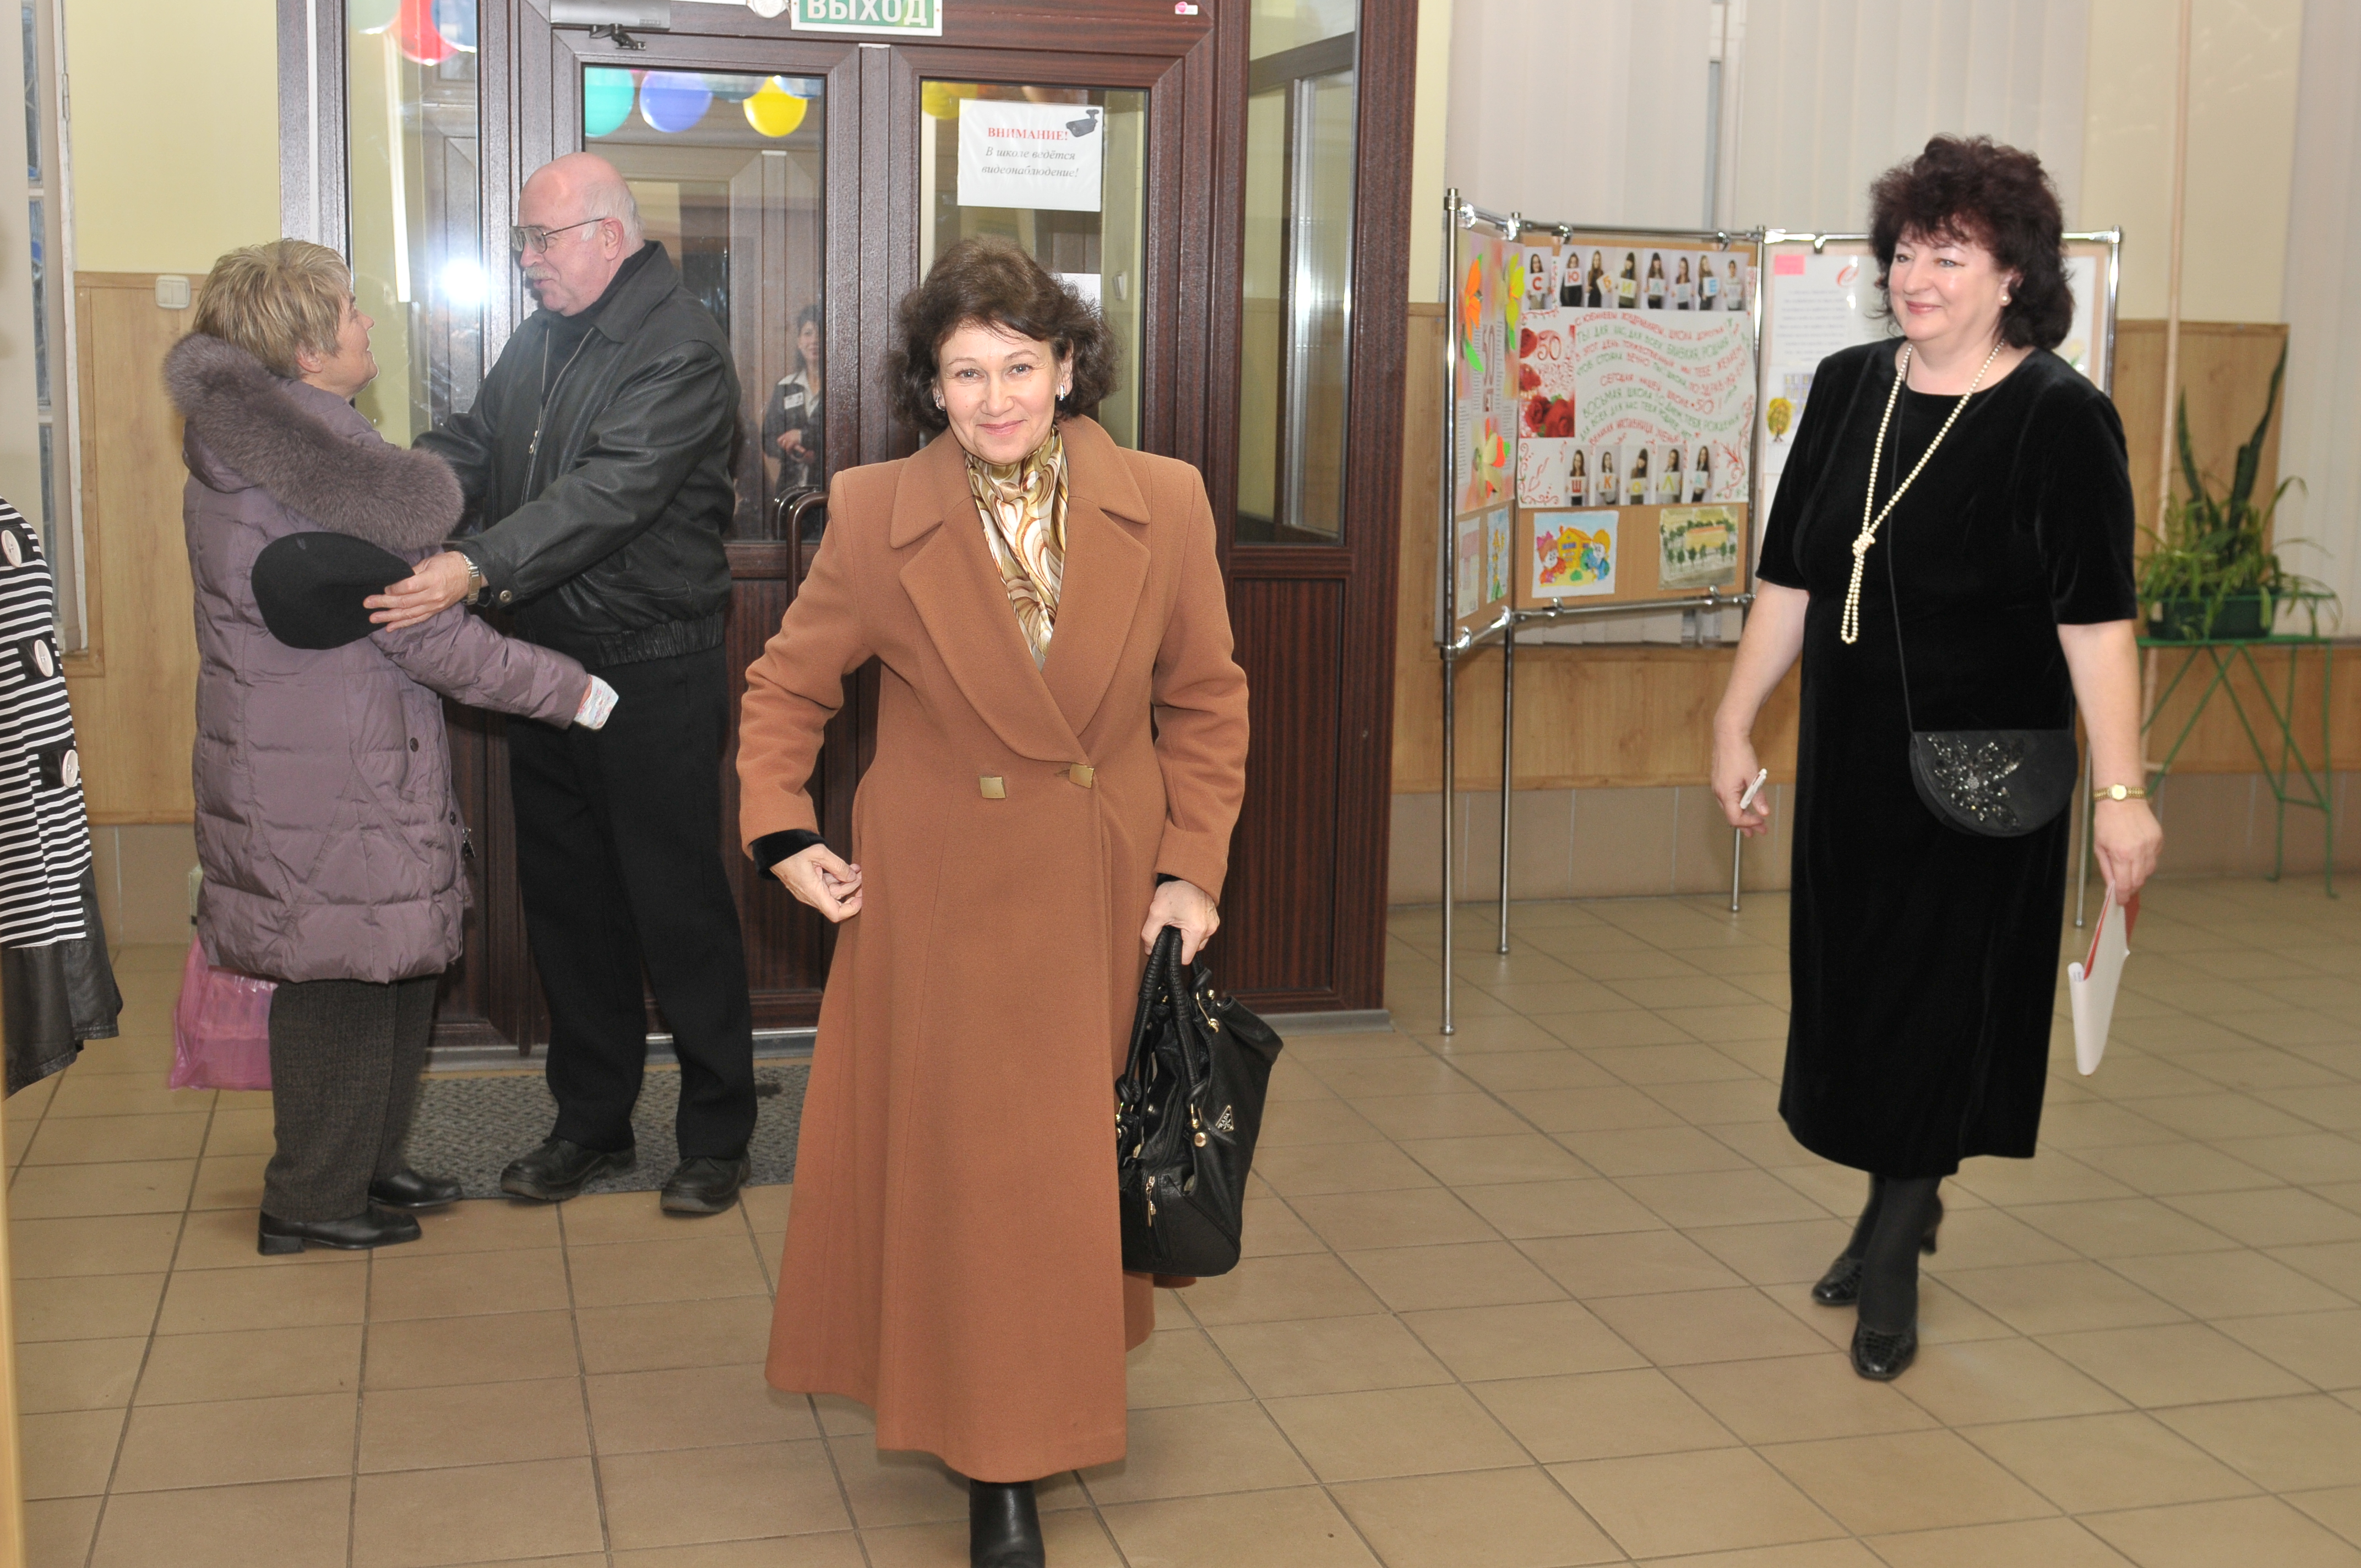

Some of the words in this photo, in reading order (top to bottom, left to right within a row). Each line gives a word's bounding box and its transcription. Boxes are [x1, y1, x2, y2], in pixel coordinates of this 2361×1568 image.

[807, 0, 927, 26] ВЫХОД
[988, 127, 1069, 141] ВНИМАНИЕ!
[986, 146, 993, 156] В
[996, 149, 1030, 158] школе
[1032, 149, 1075, 160] ведётся
[981, 165, 1079, 177] видеонаблюдение!
[1537, 330, 1562, 361] 50
[1217, 1113, 1231, 1129] PRADA
